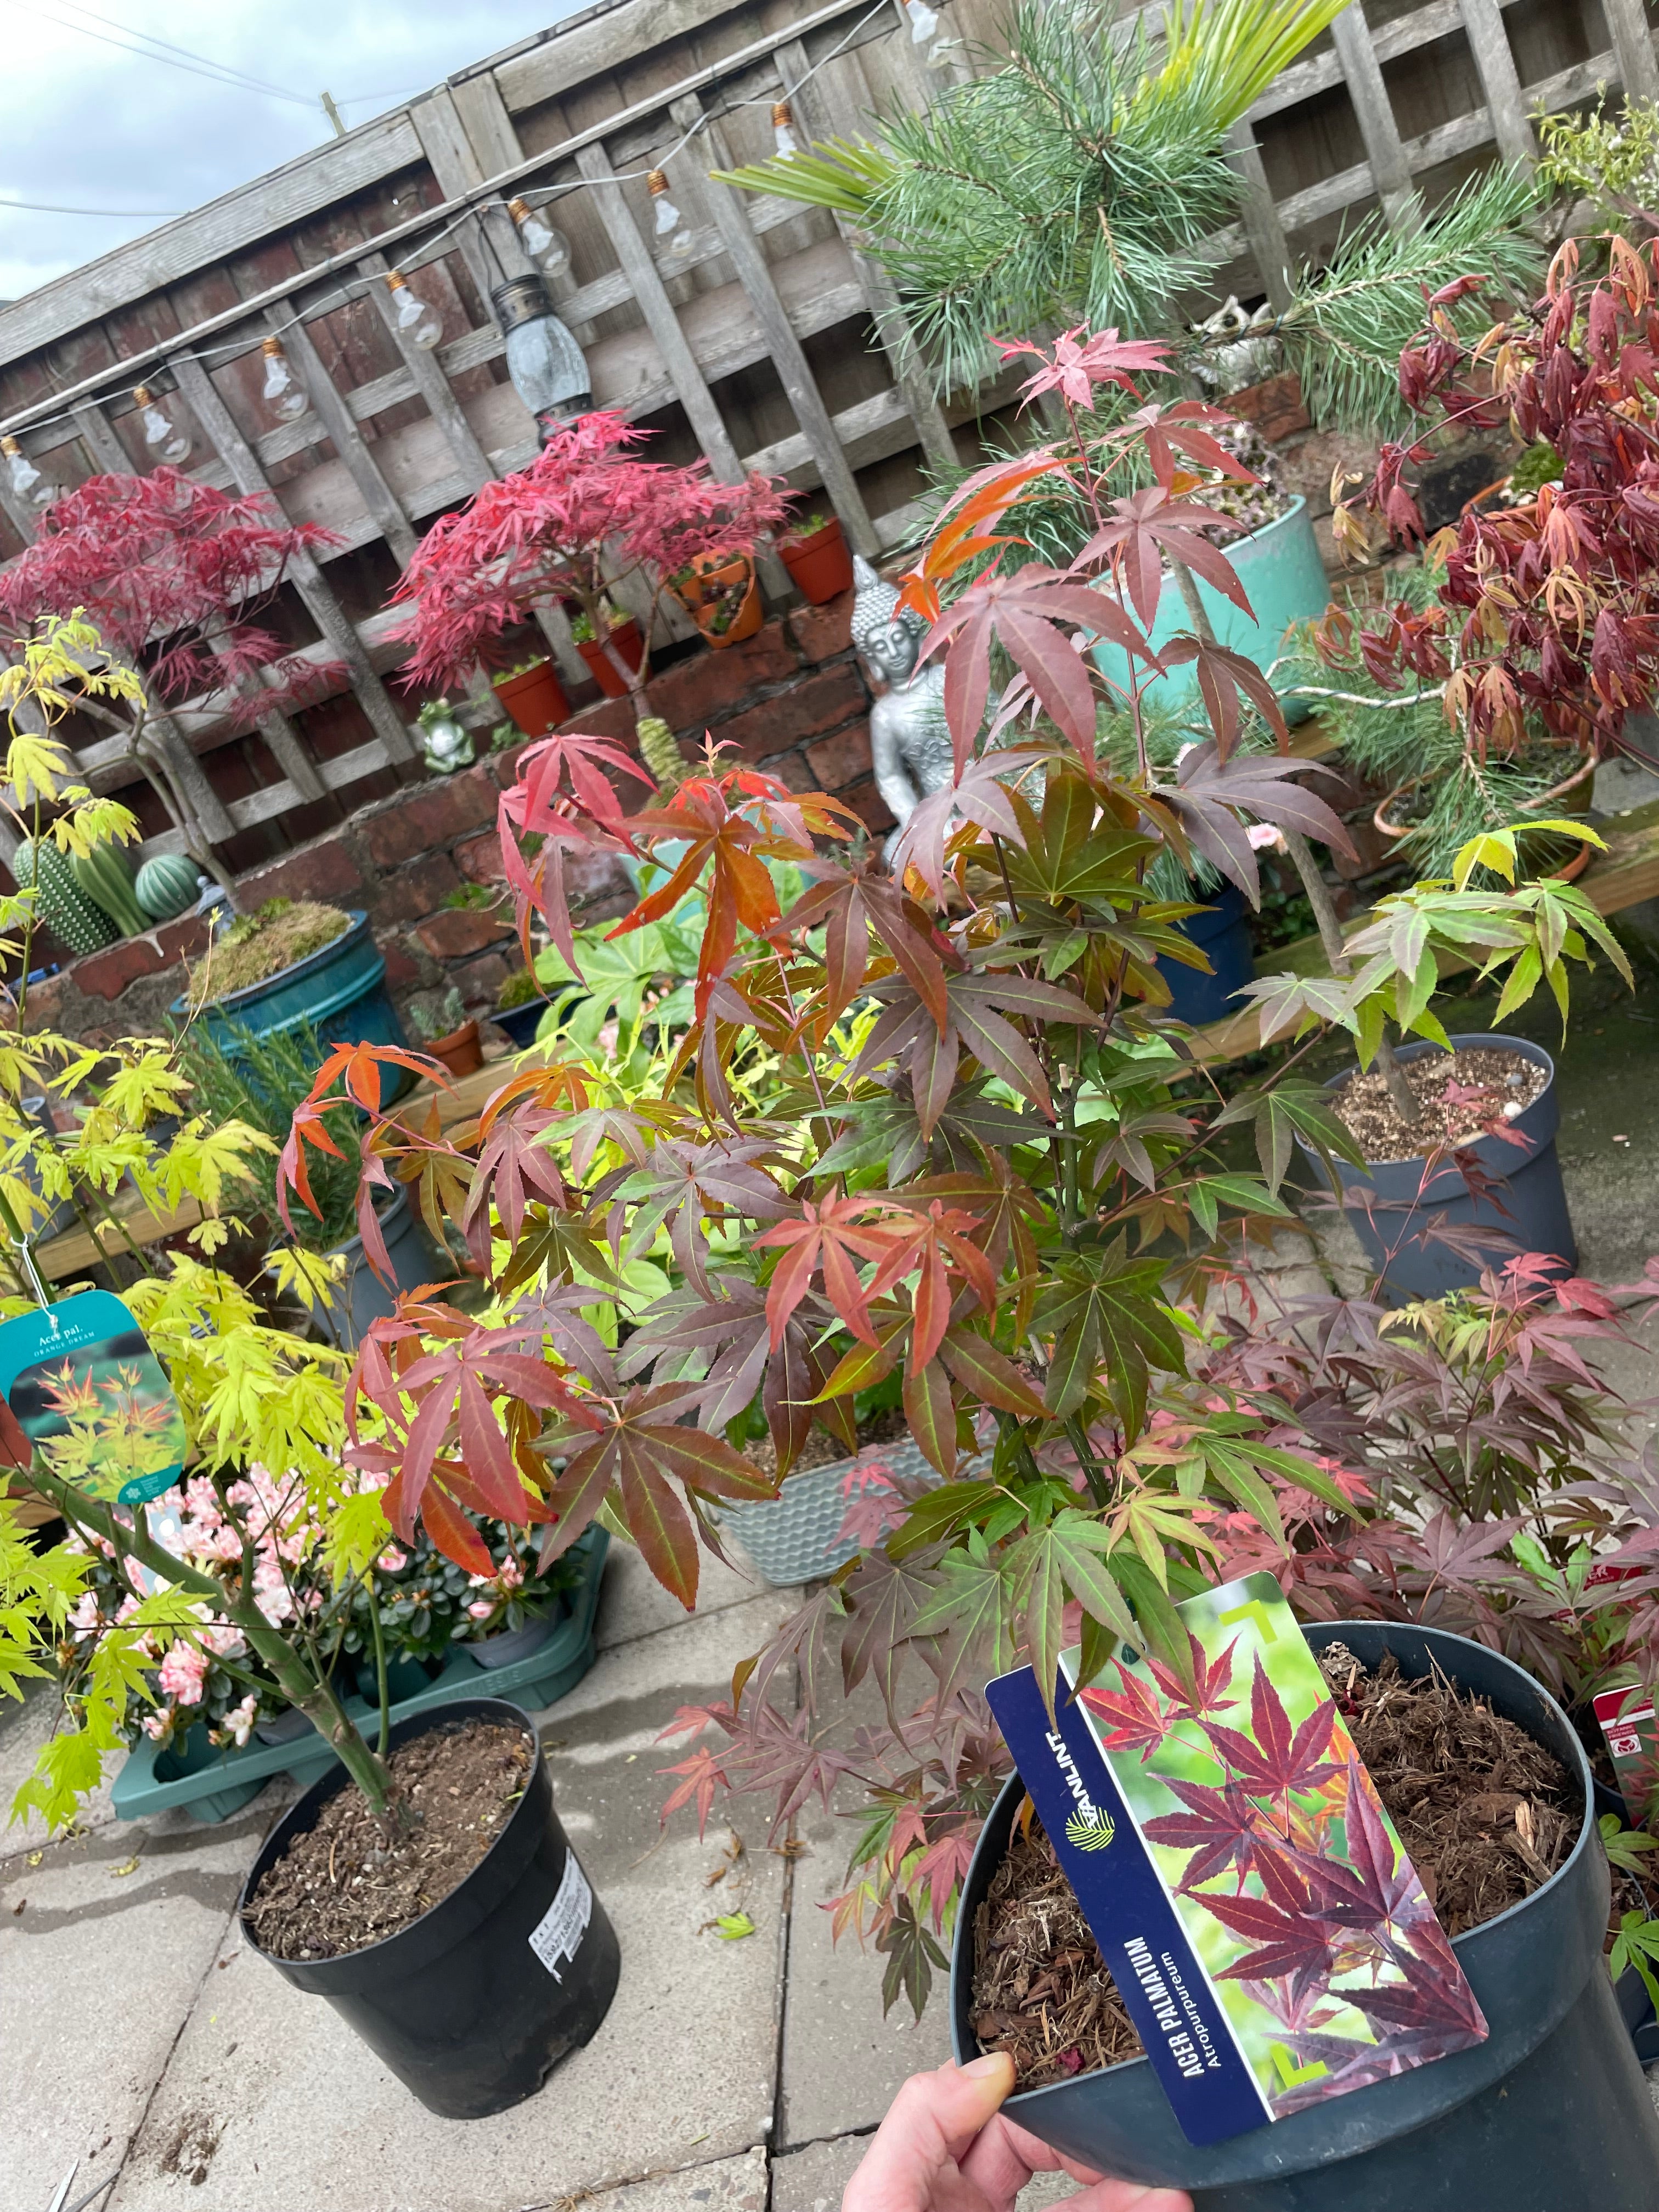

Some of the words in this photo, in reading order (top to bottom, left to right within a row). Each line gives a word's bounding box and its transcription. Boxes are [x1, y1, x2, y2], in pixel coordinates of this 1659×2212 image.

[34, 1342, 65, 1357] ORANGE
[68, 1331, 94, 1345] DREAM
[40, 1334, 60, 1346] Ace
[64, 1324, 83, 1339] pal.
[1046, 1731, 1098, 1829] VANLINT
[1124, 1937, 1182, 2031] PALMATUM
[1161, 1952, 1221, 2067] Atropurpureum
[1169, 2032, 1205, 2077] ACER
